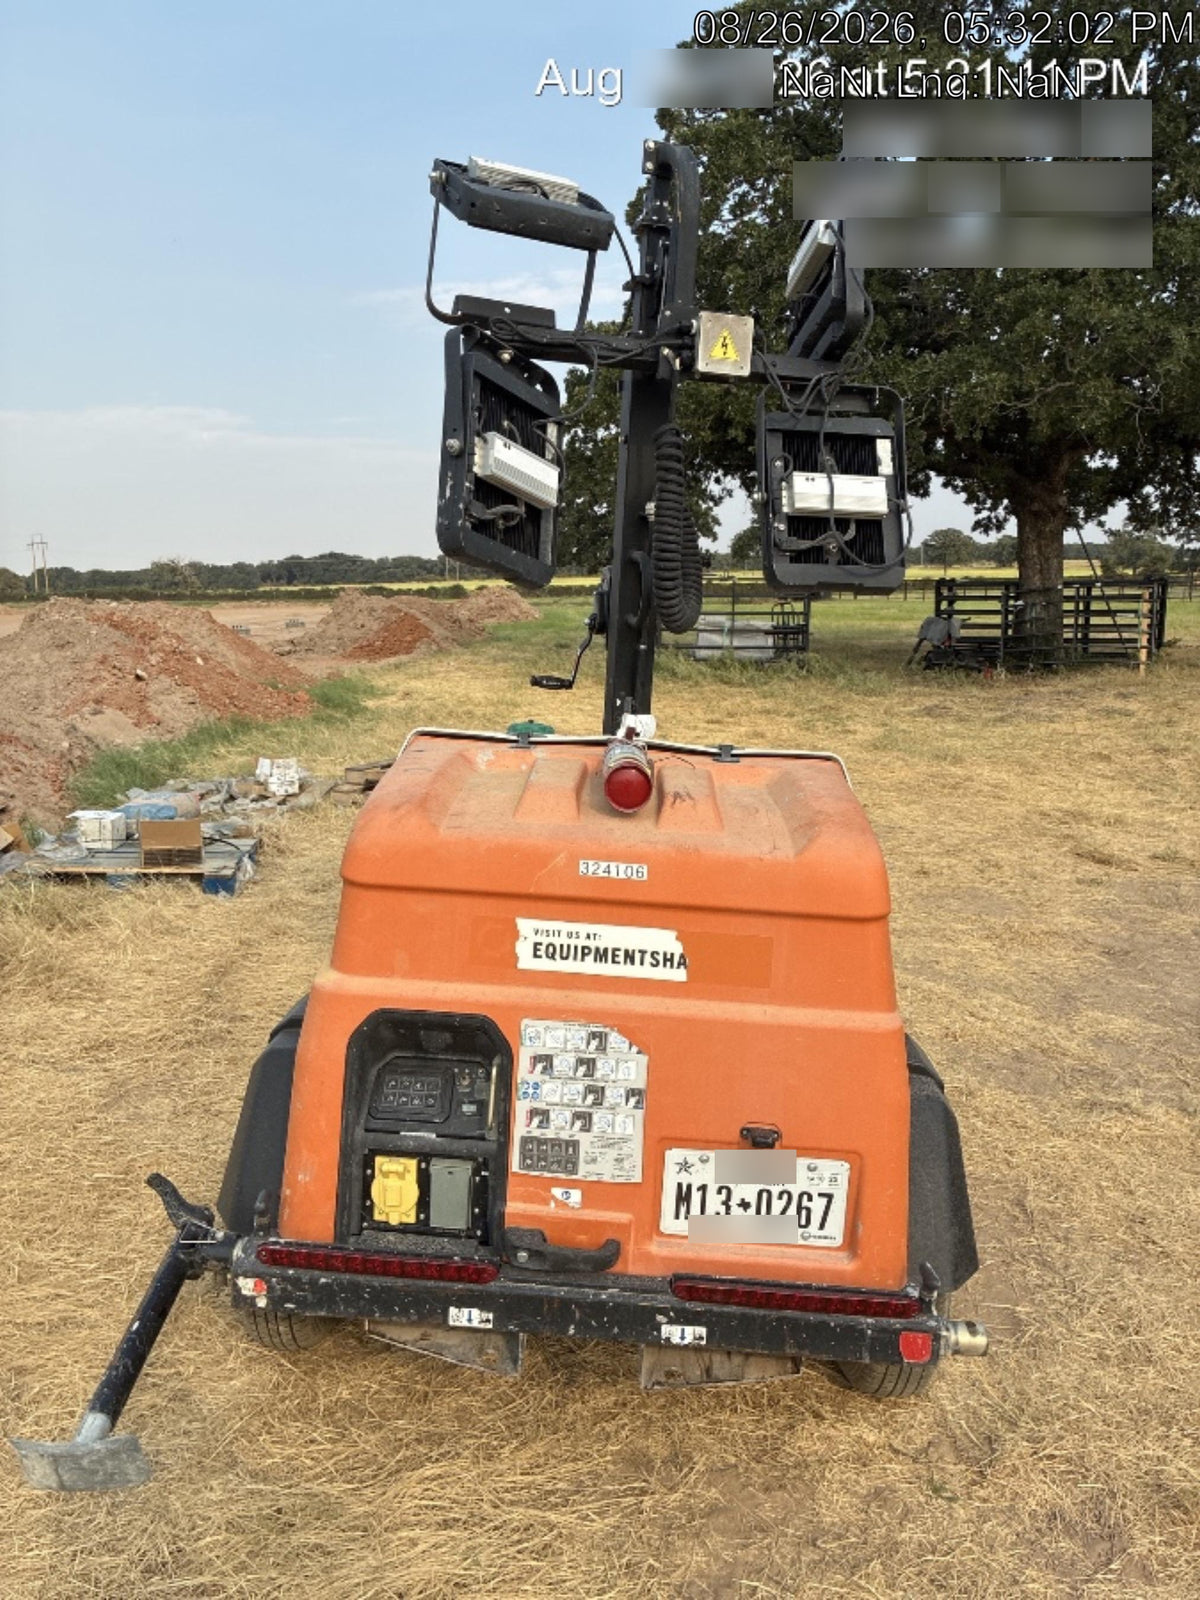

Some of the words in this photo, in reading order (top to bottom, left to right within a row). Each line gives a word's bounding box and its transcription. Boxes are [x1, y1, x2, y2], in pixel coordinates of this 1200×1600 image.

[580, 861, 646, 879] 324106
[533, 928, 562, 939] VISIT
[567, 930, 580, 940] US
[585, 932, 602, 942] AT:
[532, 942, 689, 970] EQUIPMENTSHA
